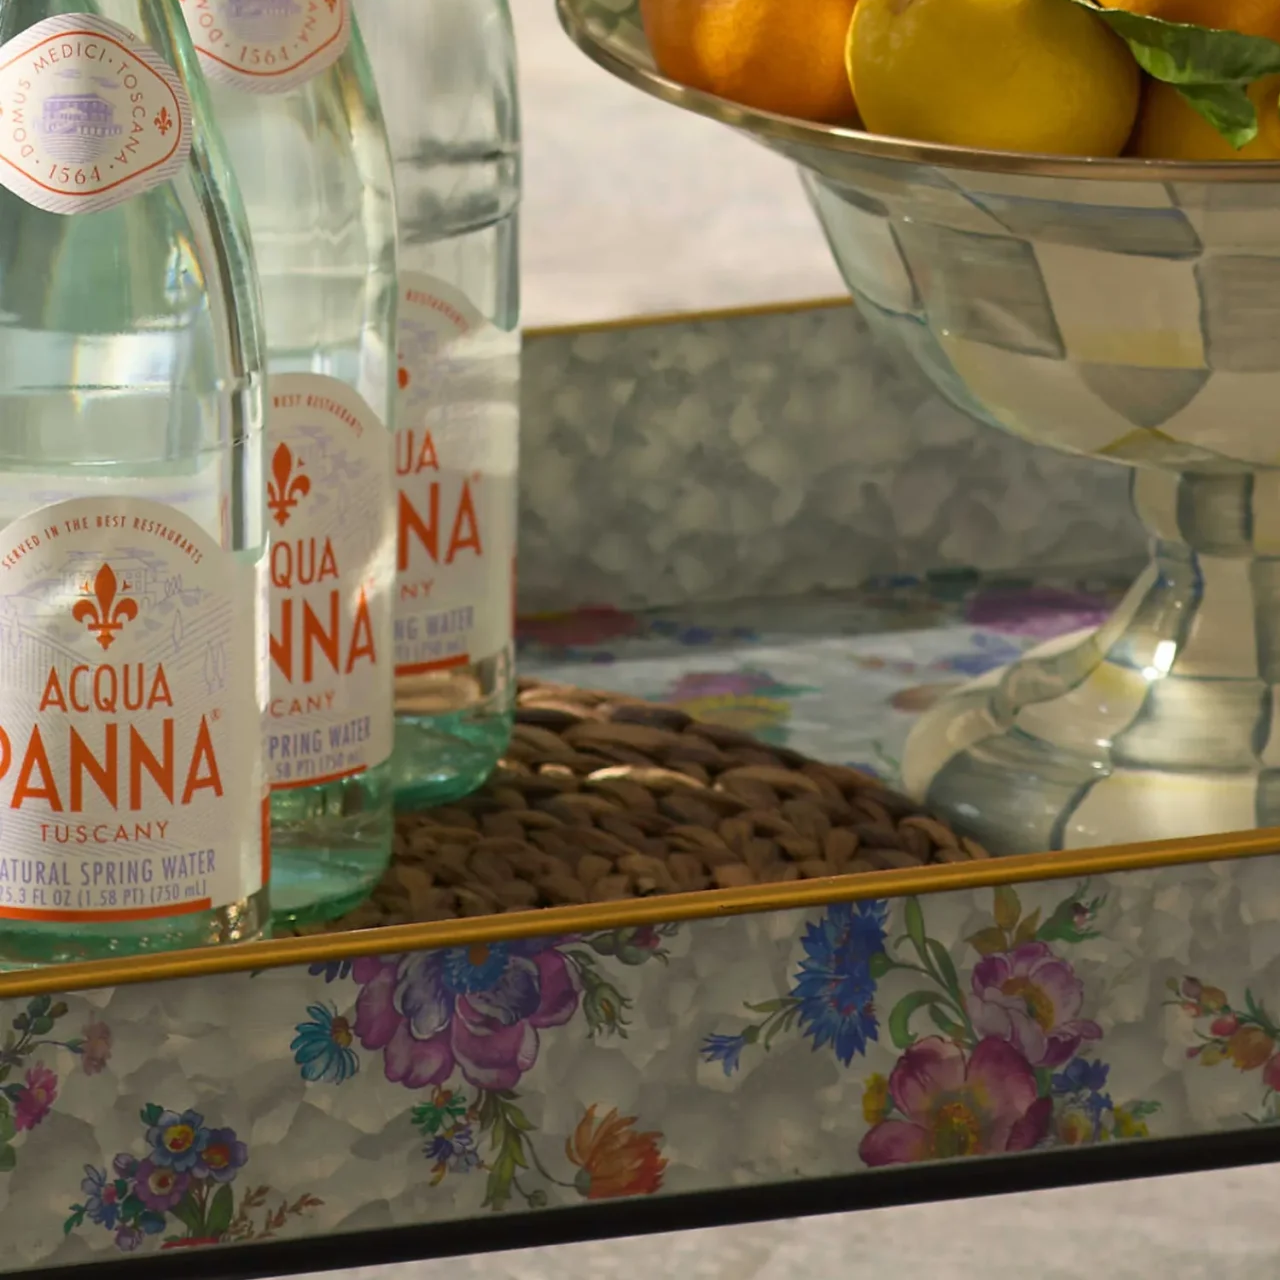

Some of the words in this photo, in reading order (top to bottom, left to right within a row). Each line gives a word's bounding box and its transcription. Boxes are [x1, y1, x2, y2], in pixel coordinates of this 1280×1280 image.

[12, 78, 35, 158] DOMUS
[33, 42, 107, 74] MEDICI
[114, 61, 146, 164] TOSCANA
[49, 164, 101, 185] 1564
[2, 534, 41, 570] SERVED
[44, 525, 60, 540] IN
[65, 516, 89, 533] THE
[96, 515, 127, 528] BEST
[133, 516, 204, 565] RESTAURANTS
[270, 535, 340, 589] QUA
[269, 585, 377, 684] NNA
[39, 662, 174, 714] ACQUA
[270, 688, 335, 718] CANY
[268, 728, 322, 761] PRING
[40, 821, 169, 844] TUSCANY
[0, 858, 71, 885] ATURAL
[81, 857, 153, 885] SPRING
[162, 848, 216, 880] WATER
[33, 888, 47, 905] FL
[53, 889, 71, 906] OZ
[78, 889, 118, 908] (1.58
[123, 887, 145, 906] PT)
[150, 883, 180, 904] (750
